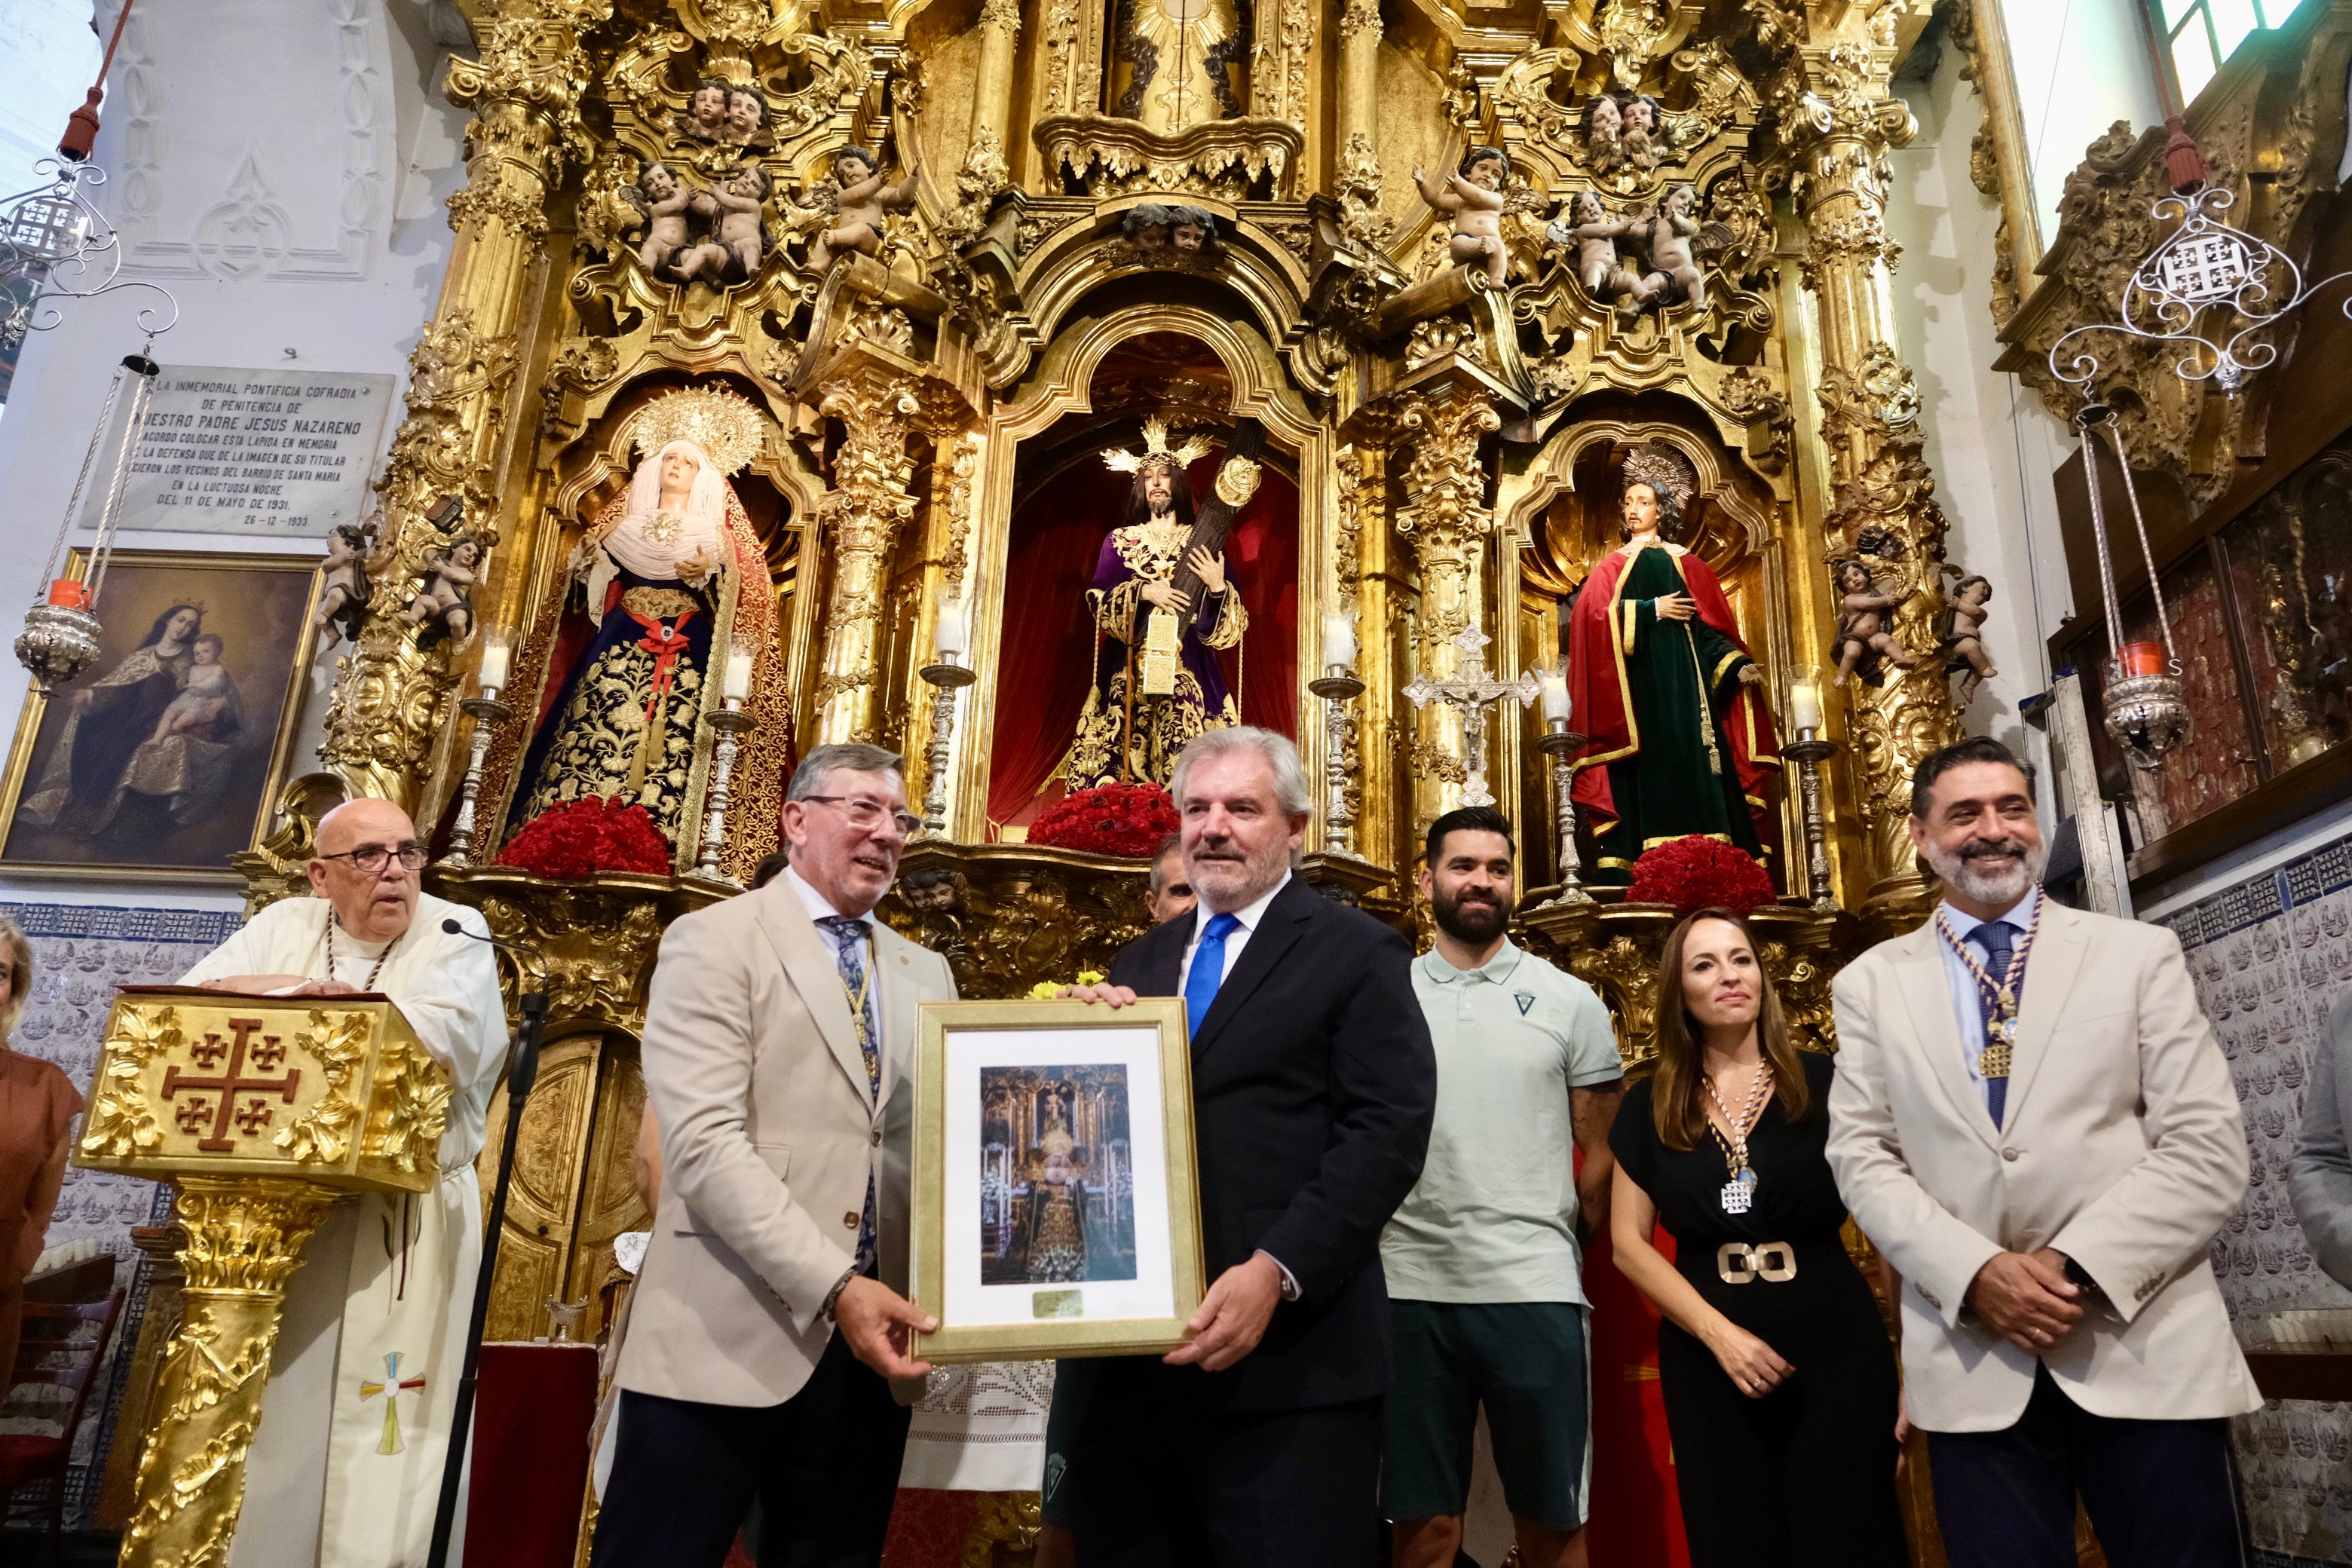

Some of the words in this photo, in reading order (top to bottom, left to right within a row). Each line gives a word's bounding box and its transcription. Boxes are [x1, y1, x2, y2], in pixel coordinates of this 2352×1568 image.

[157, 381, 170, 390] LA
[176, 381, 238, 394] INMEMORIAL
[243, 384, 301, 397] PONTIFICIA
[306, 387, 356, 399] COFRADIA
[201, 399, 216, 410] DE
[221, 400, 281, 413] PENITENCIA
[286, 403, 302, 414] DE
[198, 415, 240, 430] PADRE
[244, 418, 287, 432] JESUS
[292, 419, 361, 434] NAZARENO
[179, 433, 219, 446] COLOCAR
[222, 435, 243, 446] ESTA
[282, 437, 295, 449] EN
[298, 439, 338, 450] MEMORIA
[143, 447, 155, 458] LA
[157, 448, 195, 459] DEFENSA
[198, 450, 217, 461] QUE
[218, 451, 231, 461] DE
[231, 452, 243, 462] LA
[245, 452, 278, 464] IMAGEN
[280, 454, 293, 464] DE
[295, 455, 307, 464] SU
[309, 455, 347, 467] TITULAR
[164, 464, 182, 475] LOS
[185, 465, 220, 476] VECINOS
[222, 467, 237, 478] DEL
[242, 467, 272, 479] BARRIO
[273, 470, 285, 479] DE
[287, 470, 313, 481] SANTA
[314, 471, 341, 482] MARIA
[171, 479, 185, 491] EN
[188, 481, 199, 492] LA
[204, 482, 250, 494] LUCTUOSA
[253, 485, 283, 495] NOCHE
[157, 494, 178, 505] DEL
[184, 495, 192, 506] 11
[198, 496, 213, 507] DE
[216, 498, 246, 508] MAYO
[250, 498, 265, 510] DE
[267, 500, 290, 510] 1931.
